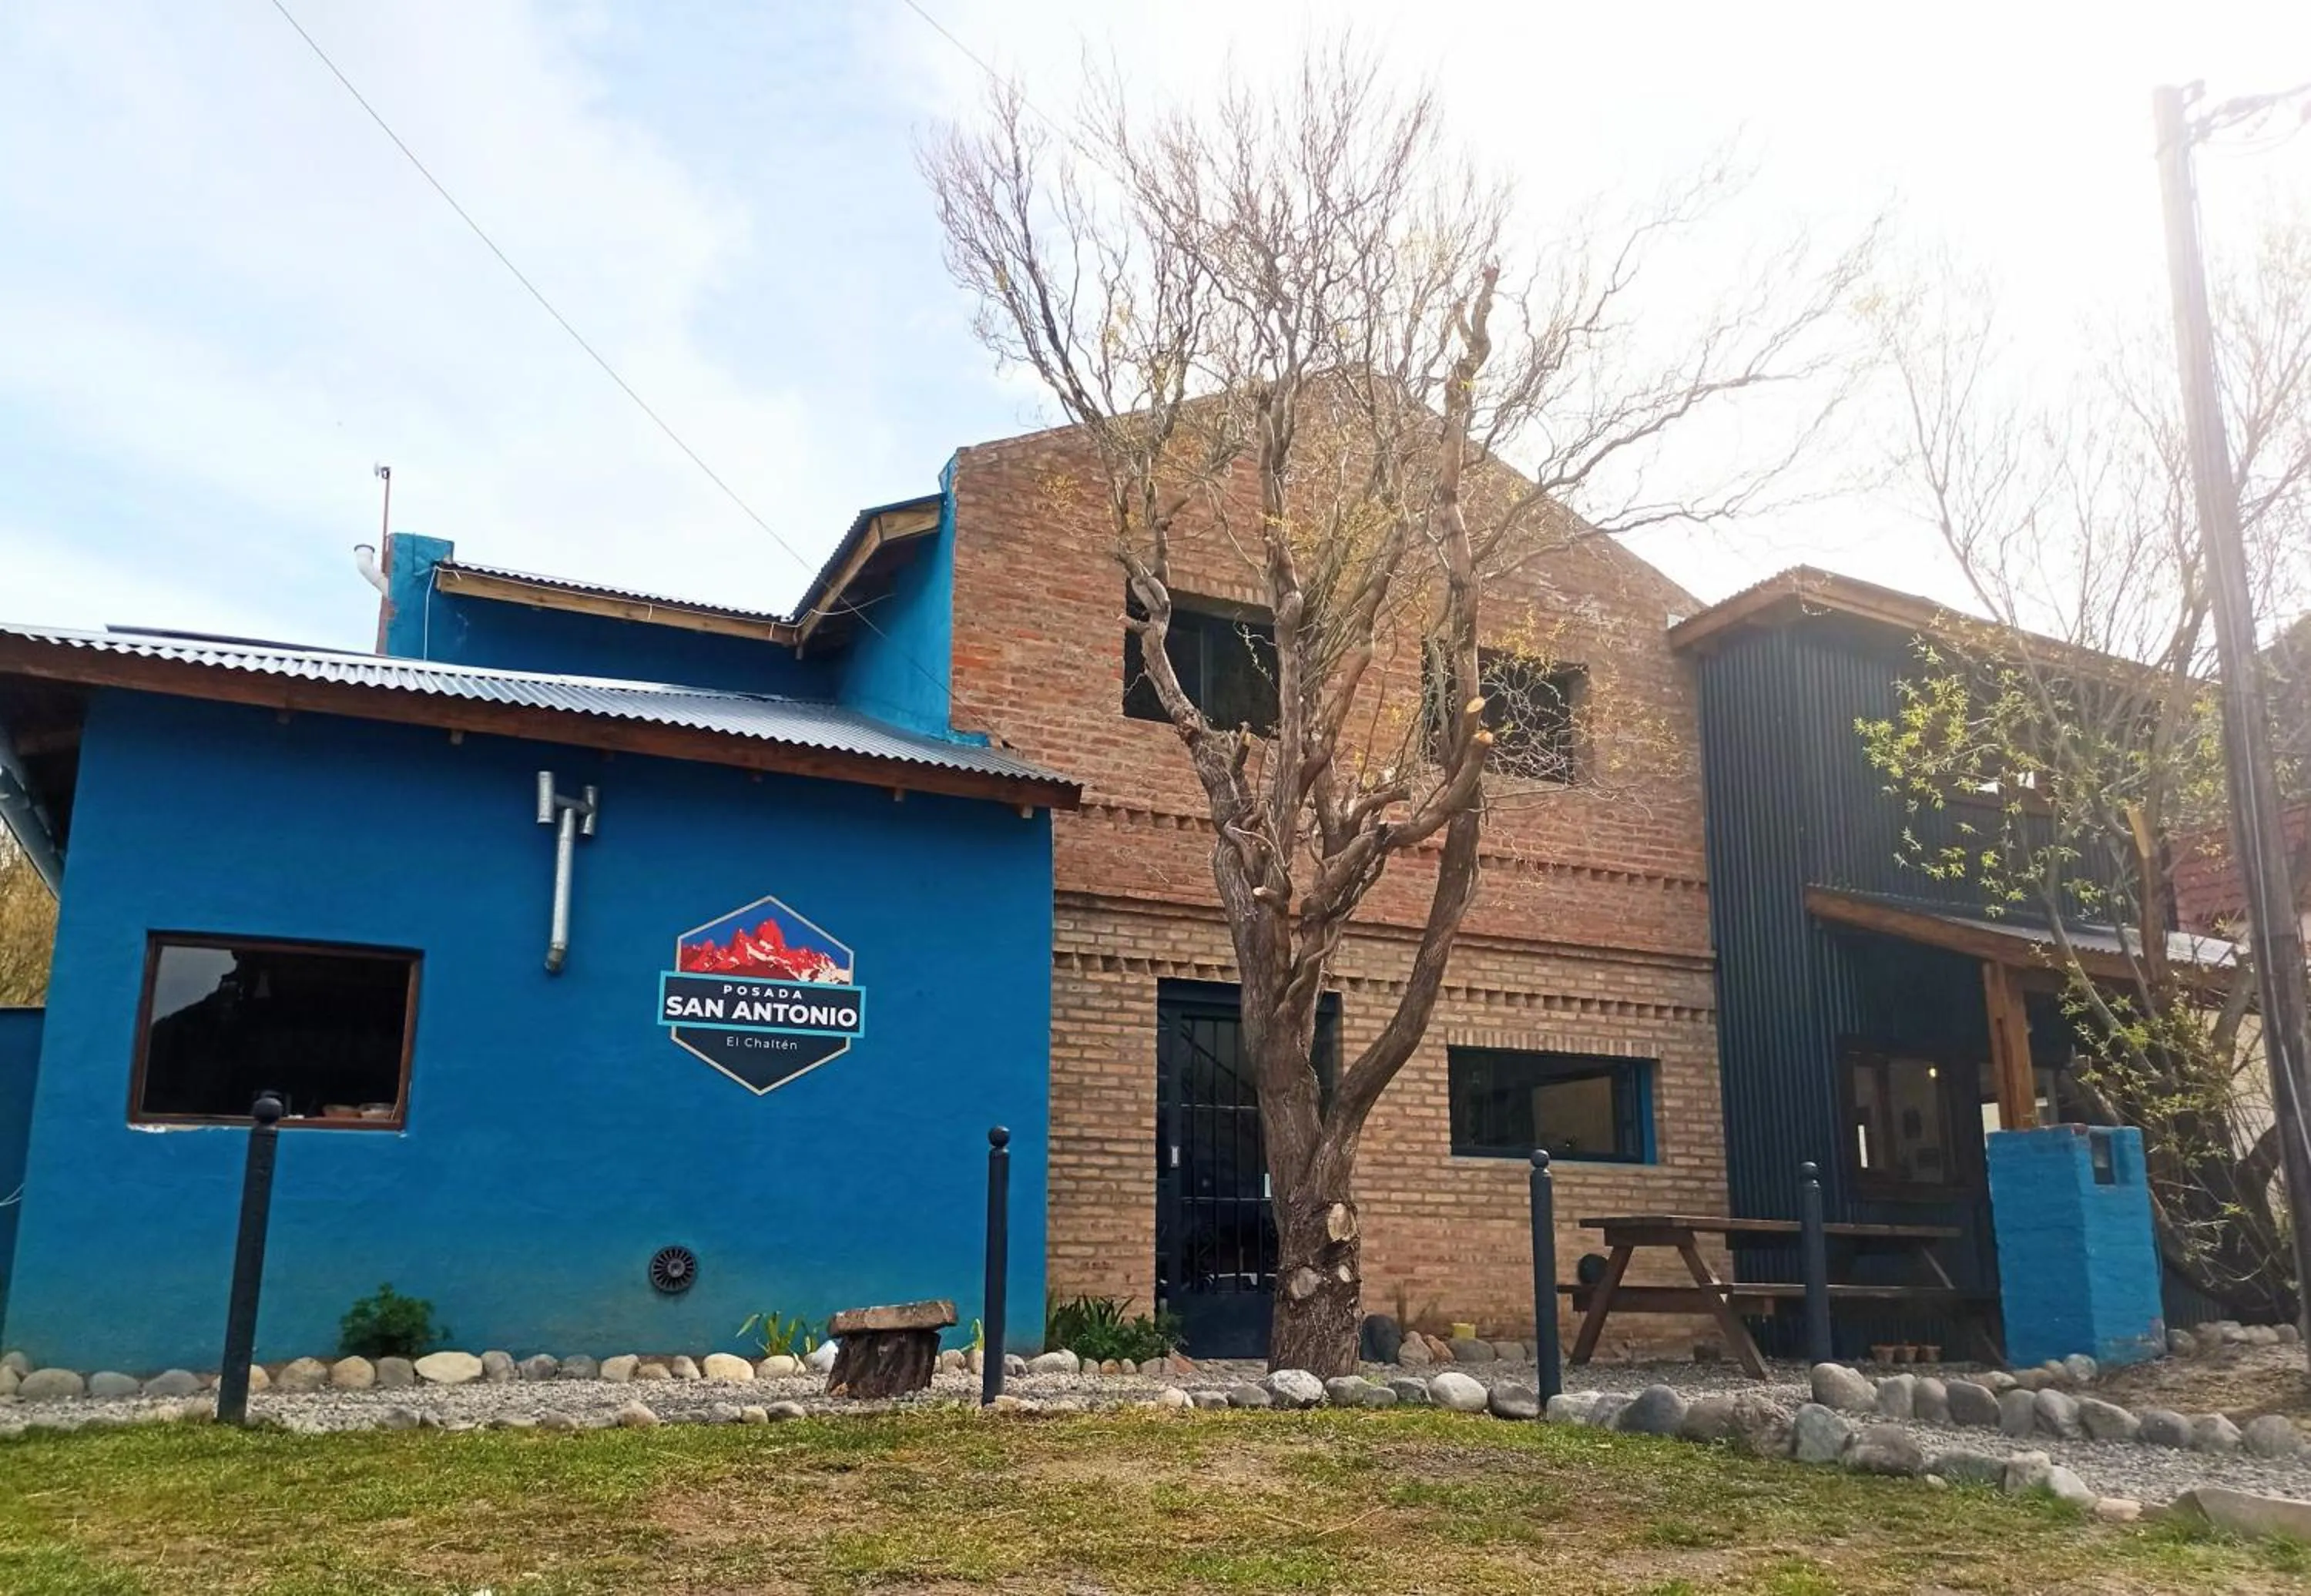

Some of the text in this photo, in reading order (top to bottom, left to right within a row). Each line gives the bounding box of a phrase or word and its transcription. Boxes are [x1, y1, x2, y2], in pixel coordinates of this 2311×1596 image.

[723, 984, 803, 1000] POSADA
[666, 996, 857, 1027] SAN ANTONIO
[726, 1036, 798, 1051] El Chaltén
